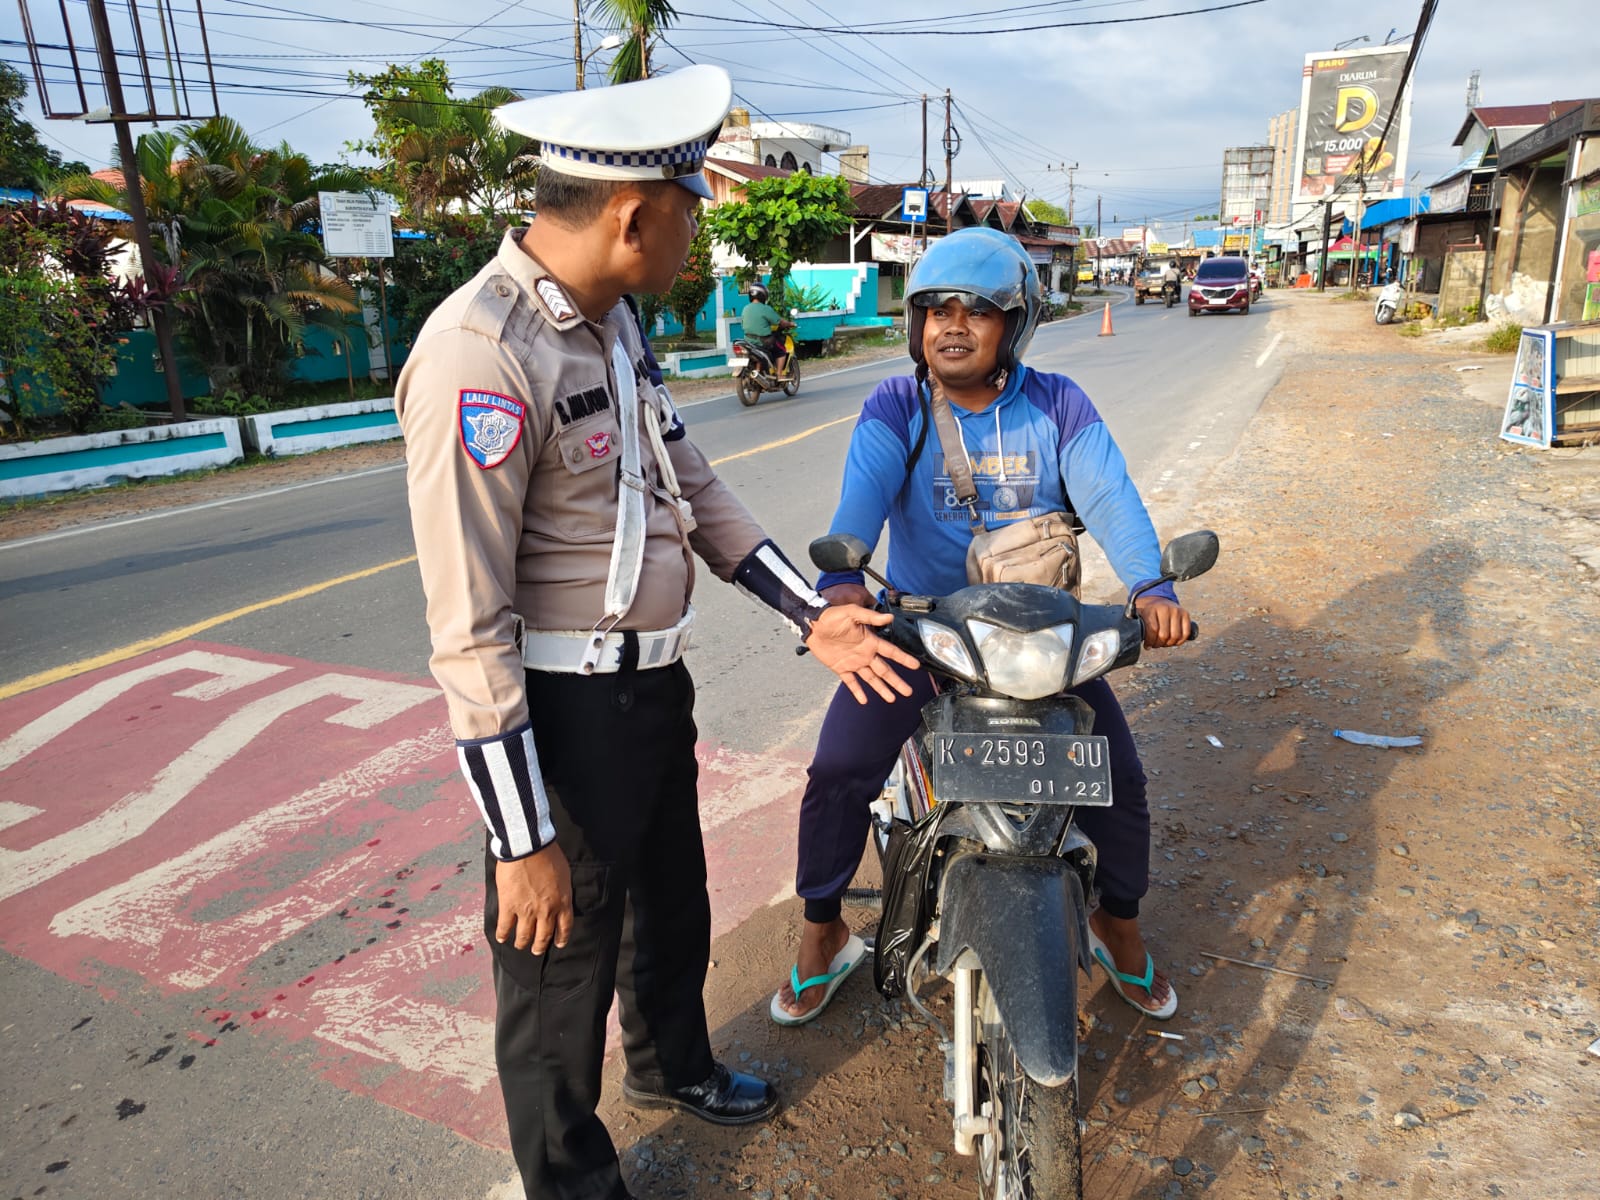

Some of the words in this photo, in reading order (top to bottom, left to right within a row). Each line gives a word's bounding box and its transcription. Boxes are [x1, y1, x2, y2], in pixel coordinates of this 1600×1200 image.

[1335, 85, 1379, 134] D
[1324, 137, 1363, 152] 15.000
[466, 393, 489, 404] LALU
[491, 396, 521, 415] LINTAS
[987, 717, 1041, 727] HONDA
[940, 738, 956, 765] K
[980, 739, 1046, 767] 2593
